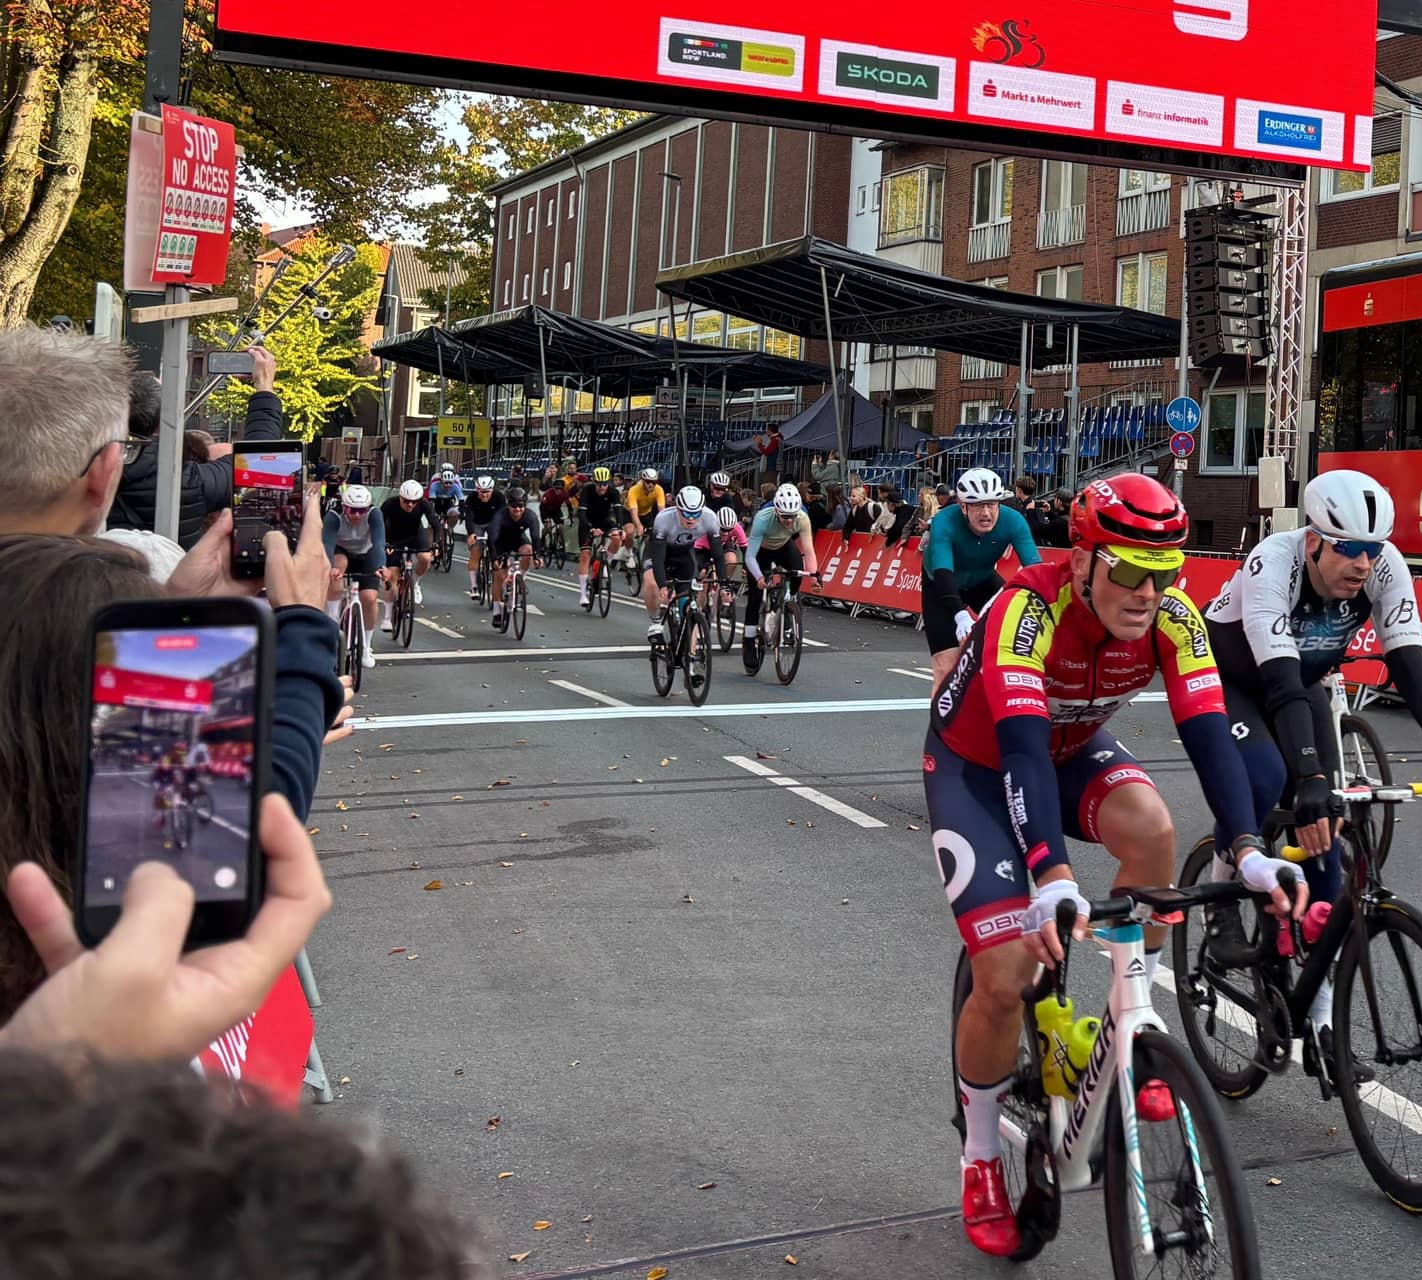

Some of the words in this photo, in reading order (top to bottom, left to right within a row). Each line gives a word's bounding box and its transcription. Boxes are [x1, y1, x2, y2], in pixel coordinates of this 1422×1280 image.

[1001, 90, 1029, 103] Markt
[1037, 95, 1082, 110] Mehrwert
[1137, 108, 1162, 120] finanz
[1163, 113, 1209, 126] informatik
[1264, 117, 1307, 134] ERDINGER
[183, 119, 219, 163] STOP
[172, 157, 188, 187] NO
[193, 166, 229, 195] ACCESS
[451, 422, 465, 433] 50
[1091, 479, 1123, 505] UDY
[896, 568, 922, 593] Spark
[976, 912, 1024, 936] DBK
[1063, 1002, 1116, 1160] MERIDA
